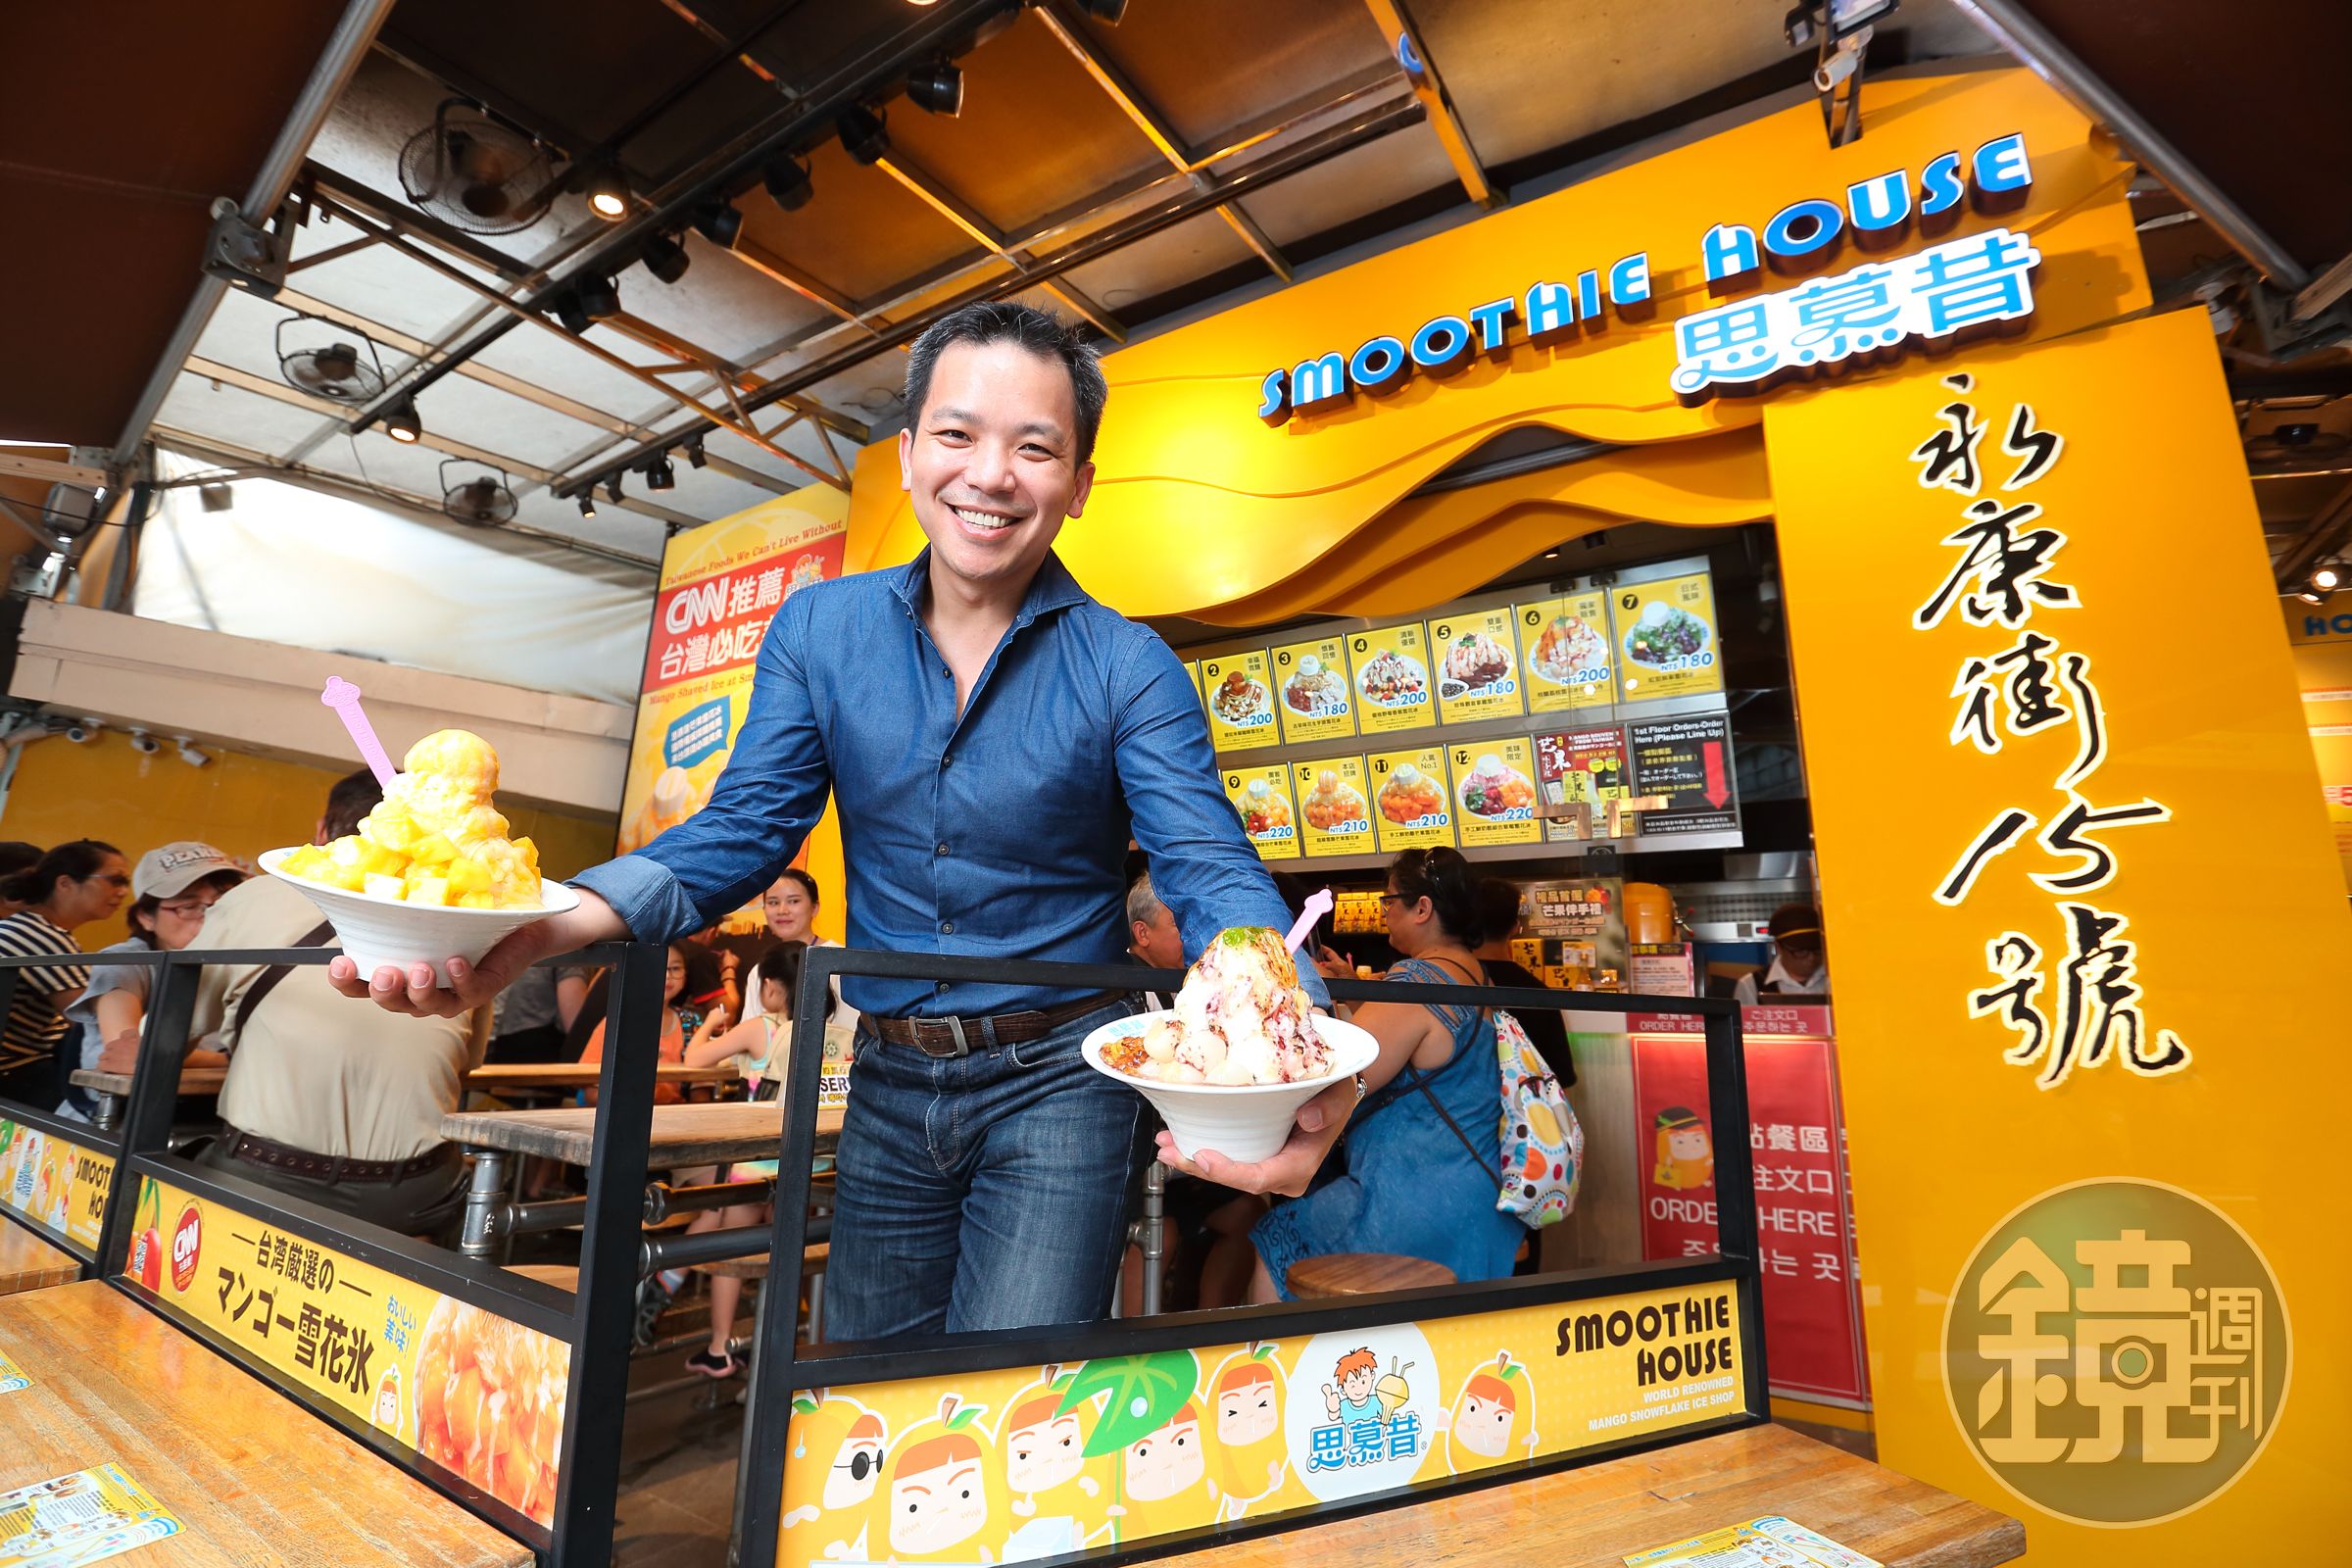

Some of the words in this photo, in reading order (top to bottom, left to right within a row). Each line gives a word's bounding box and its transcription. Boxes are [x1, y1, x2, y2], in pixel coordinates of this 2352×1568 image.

[1258, 251, 1652, 417] SMOOTHIE
[1701, 131, 2034, 283] HOUSE
[1672, 231, 2040, 394] 思慕昔
[709, 557, 734, 571] Foods
[737, 550, 750, 562] We
[752, 541, 777, 556] Can't
[779, 535, 799, 549] Live
[802, 520, 843, 539] Without
[665, 576, 729, 635] CNN
[1625, 596, 1636, 608] 7
[1528, 612, 1539, 623] 6
[1440, 627, 1448, 637] 5
[660, 614, 771, 680] 台灣必吃
[1356, 640, 1365, 651] 4
[1280, 654, 1289, 663] 3
[1209, 664, 1218, 675] 2
[711, 679, 724, 690] Ice
[1635, 726, 1647, 735] 1st
[1648, 725, 1671, 734] Floor
[1653, 733, 1686, 744] (Please
[1687, 730, 1706, 739] Line
[1707, 728, 1725, 738] Up)
[1376, 760, 1387, 771] 11
[1457, 752, 1470, 763] 12
[1230, 777, 1239, 787] 9
[1640, 1021, 1675, 1030] ORDER
[75, 1156, 111, 1190] SMOOT
[88, 1191, 104, 1219] HO
[1651, 1197, 1718, 1225] ORDE
[1758, 1206, 1837, 1237] HERE
[1556, 1296, 1730, 1356] SMOOTHIE
[1638, 1337, 1732, 1387] HOUSE
[1643, 1387, 1680, 1403] WORLD
[1683, 1376, 1734, 1396] RENOWNED
[1589, 1413, 1628, 1431] MANGO
[1630, 1400, 1690, 1422] SNOWFLAKE
[1692, 1396, 1707, 1409] ICE
[1710, 1391, 1735, 1405] SHOP
[1307, 1412, 1421, 1471] 思慕昔
